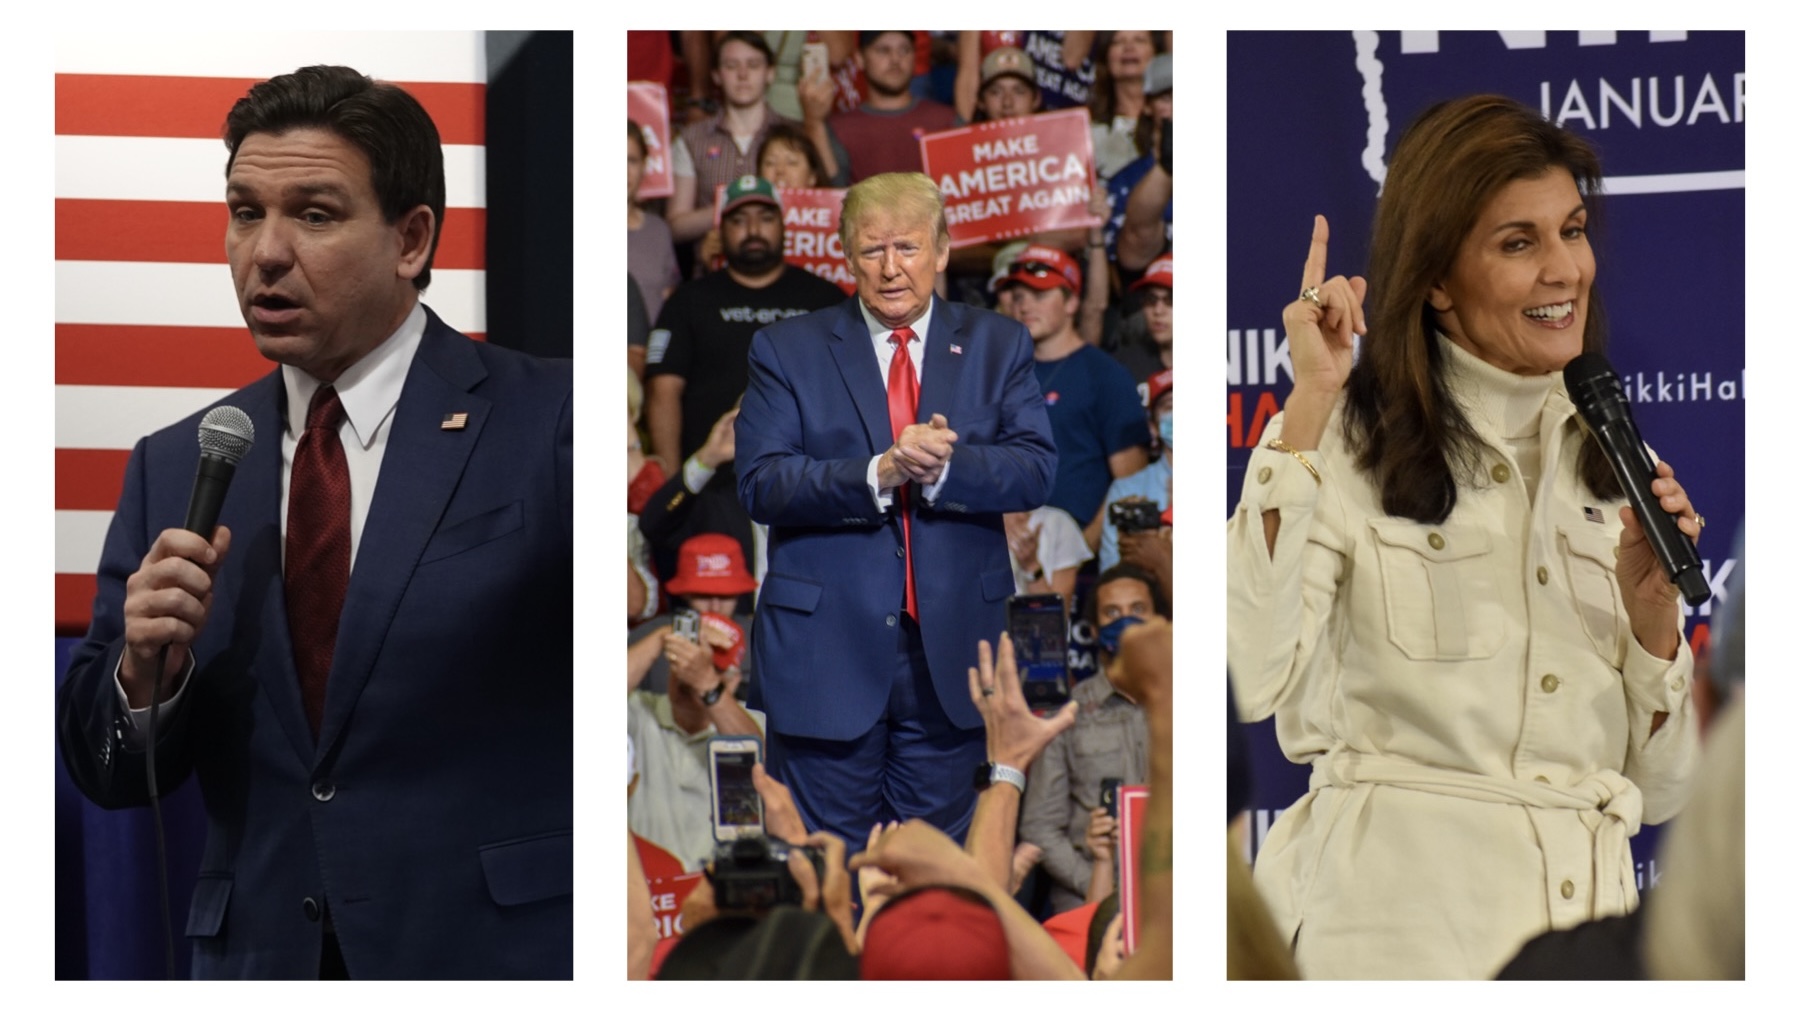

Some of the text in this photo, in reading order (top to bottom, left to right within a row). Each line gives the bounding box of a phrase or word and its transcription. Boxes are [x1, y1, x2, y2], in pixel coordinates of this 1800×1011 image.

[972, 134, 1039, 163] MAKE
[939, 153, 1087, 199] AMERICA
[945, 185, 1090, 226] GREAT AGAIN
